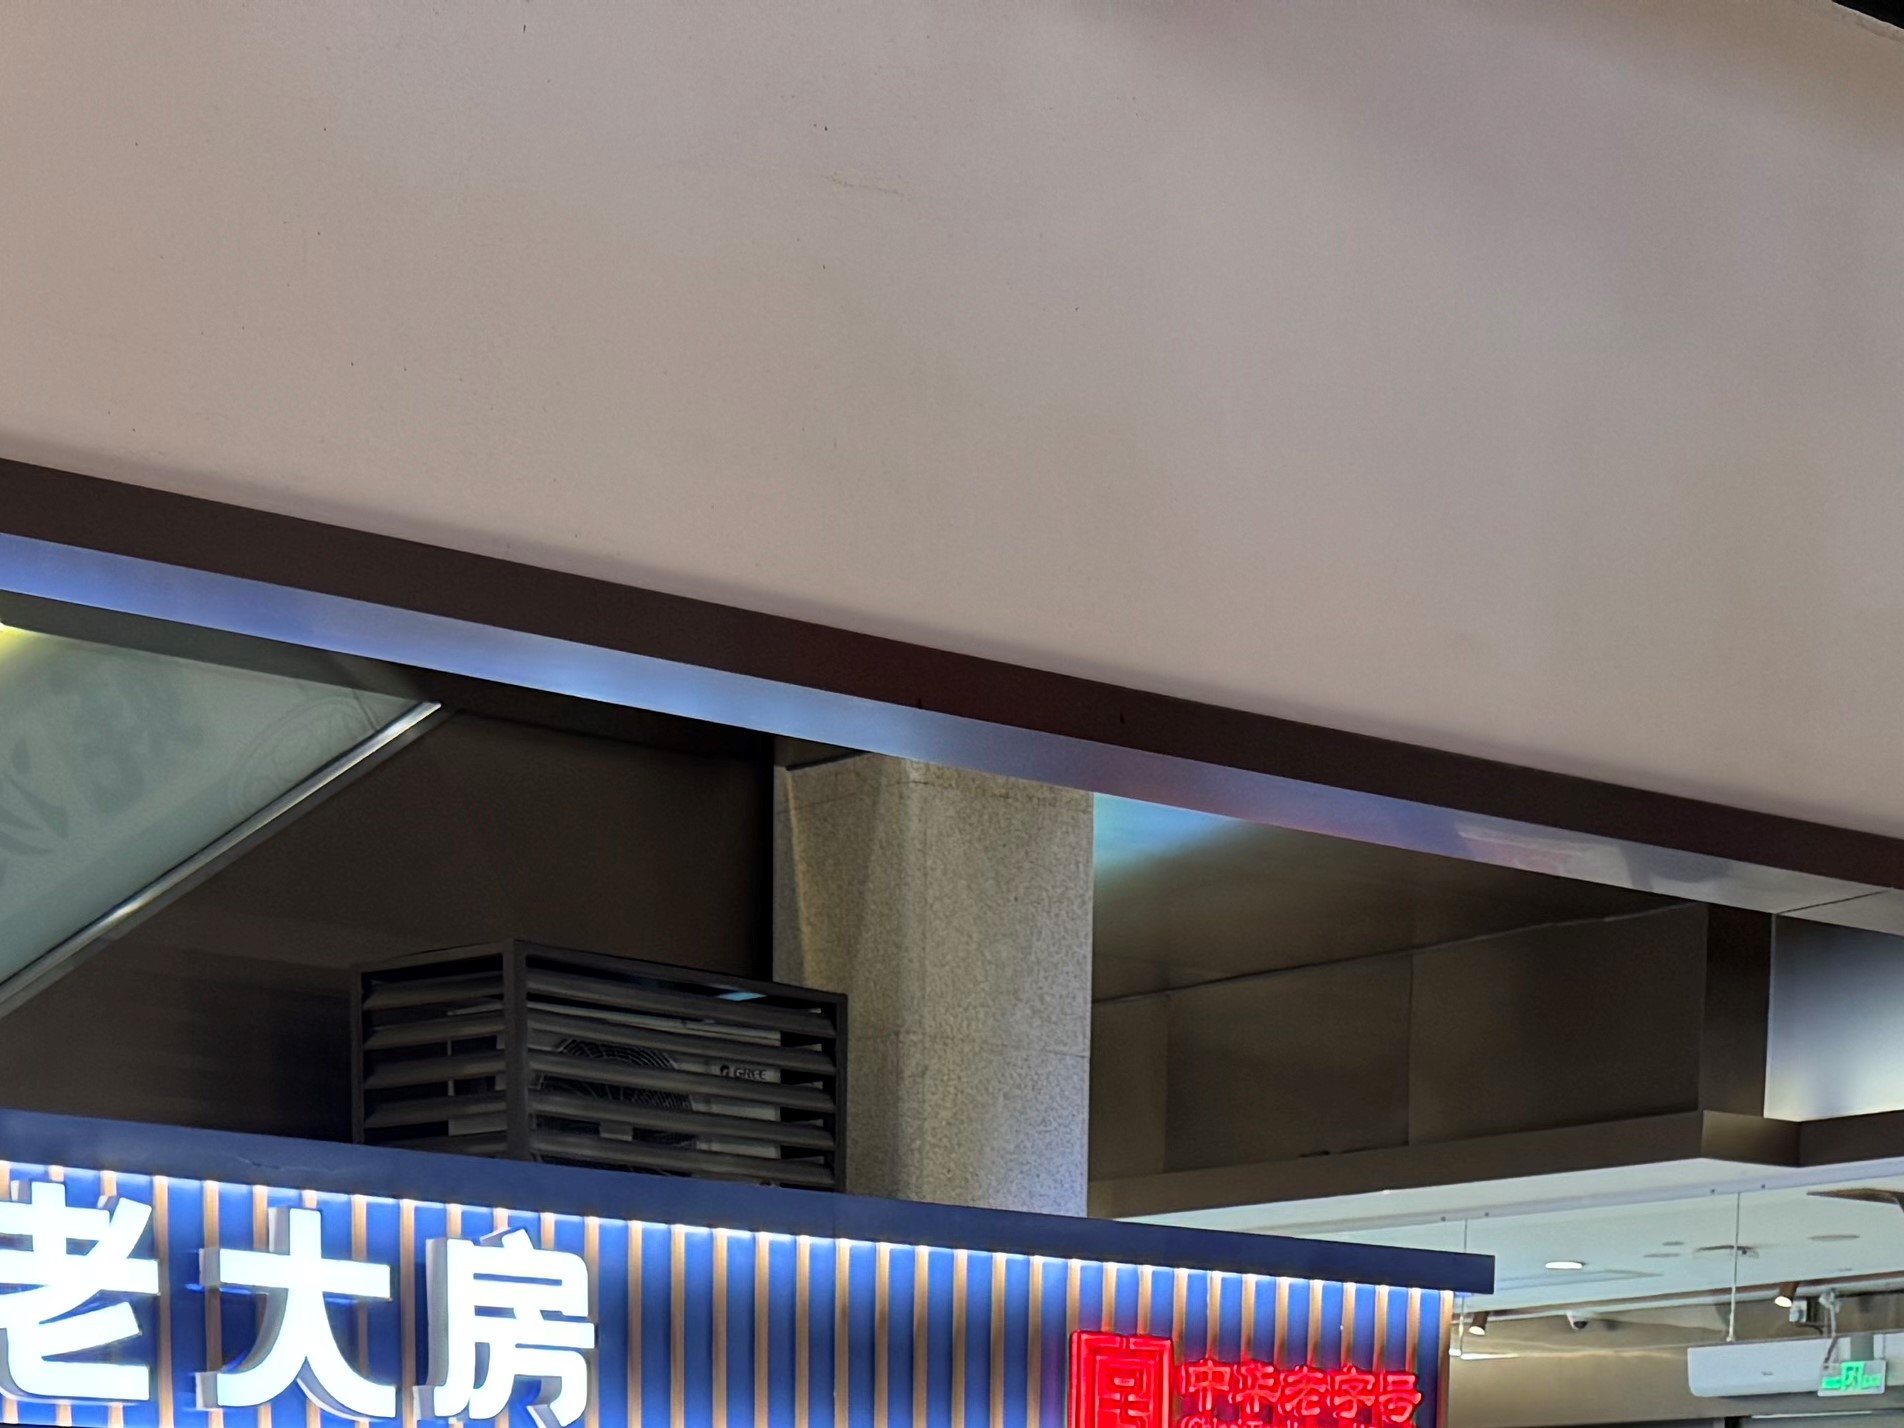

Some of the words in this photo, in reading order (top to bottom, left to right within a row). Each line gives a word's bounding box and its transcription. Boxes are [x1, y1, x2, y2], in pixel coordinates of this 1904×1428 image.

[1182, 1359, 1422, 1422] 中华老字号
